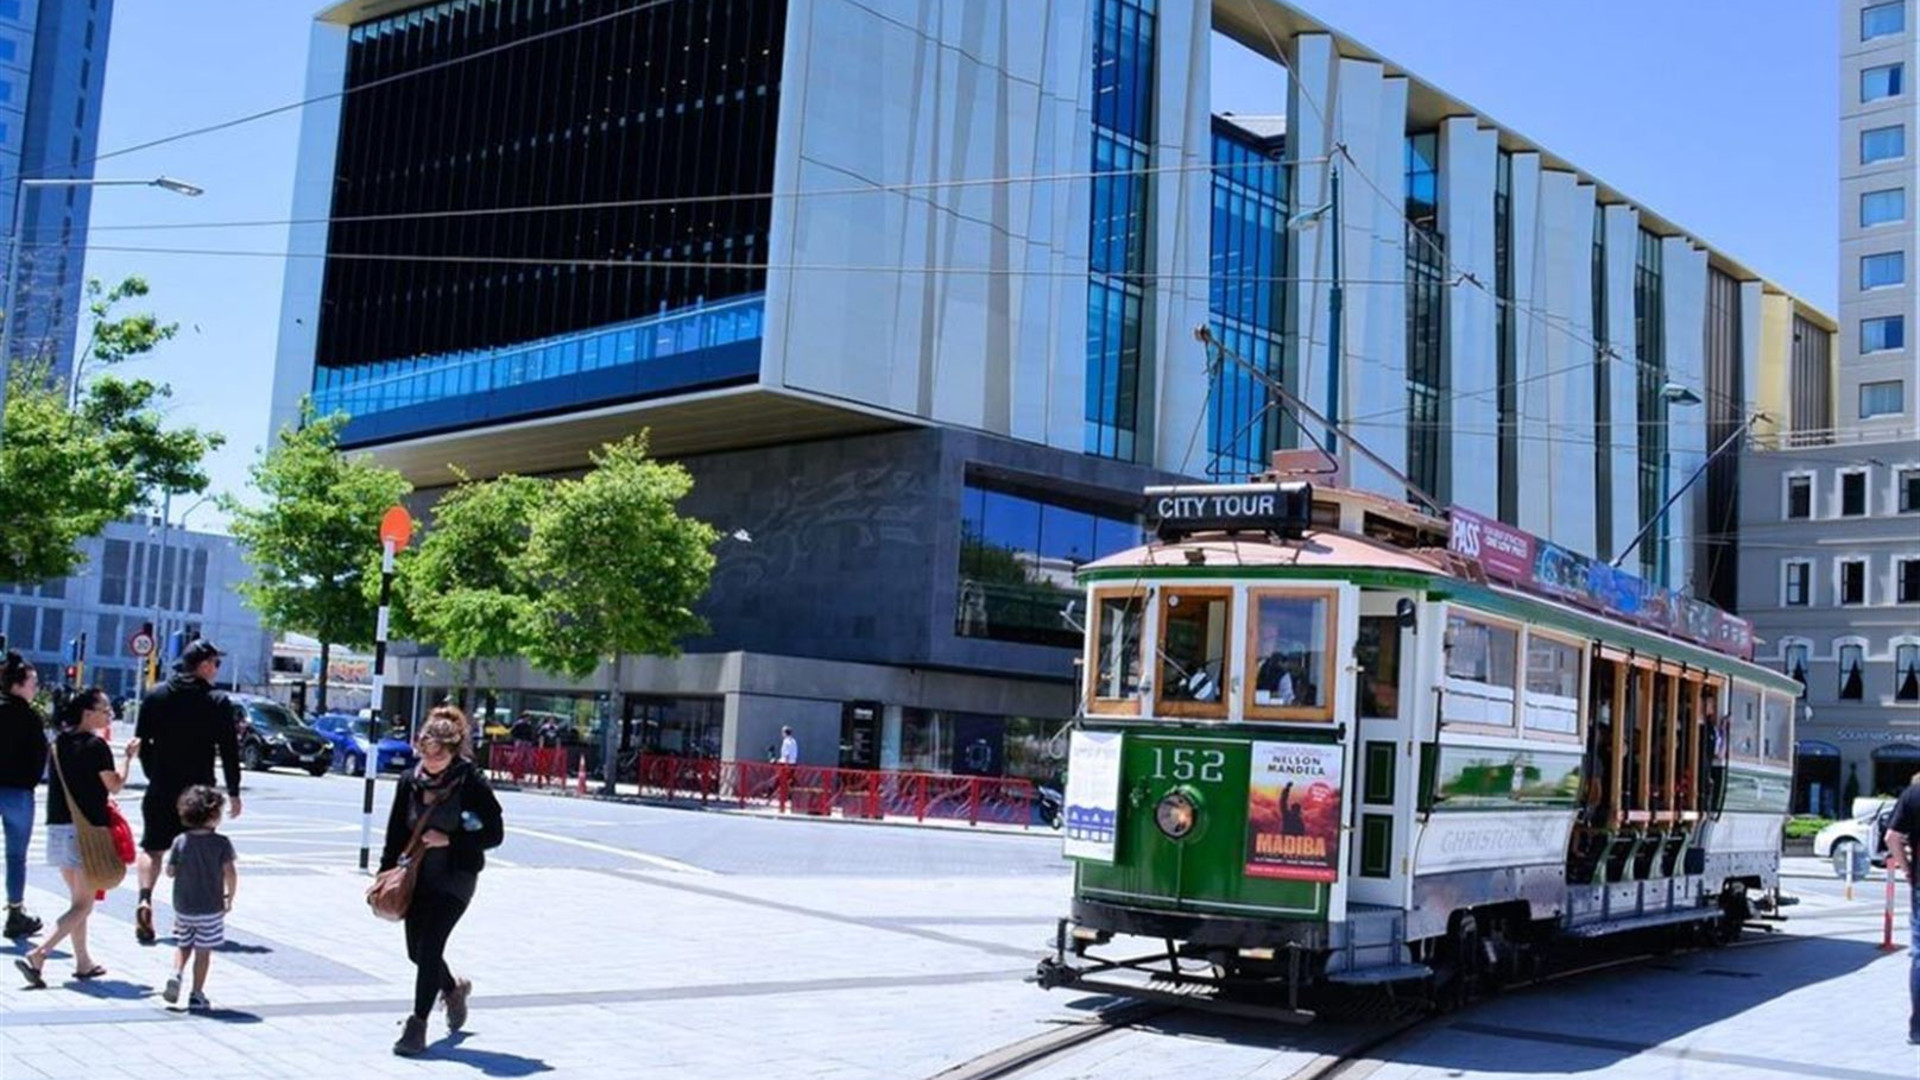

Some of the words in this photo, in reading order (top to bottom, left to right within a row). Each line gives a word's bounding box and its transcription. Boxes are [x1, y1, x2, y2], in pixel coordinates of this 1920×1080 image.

[1158, 496, 1207, 518] CITY
[1212, 495, 1274, 517] TOUR
[1452, 517, 1480, 557] PASS
[1151, 748, 1224, 782] 152
[1267, 764, 1325, 775] MANDELA
[1272, 756, 1321, 765] NELSON
[1256, 834, 1326, 857] MADIBA
[1441, 825, 1555, 853] CHRISTCHU
